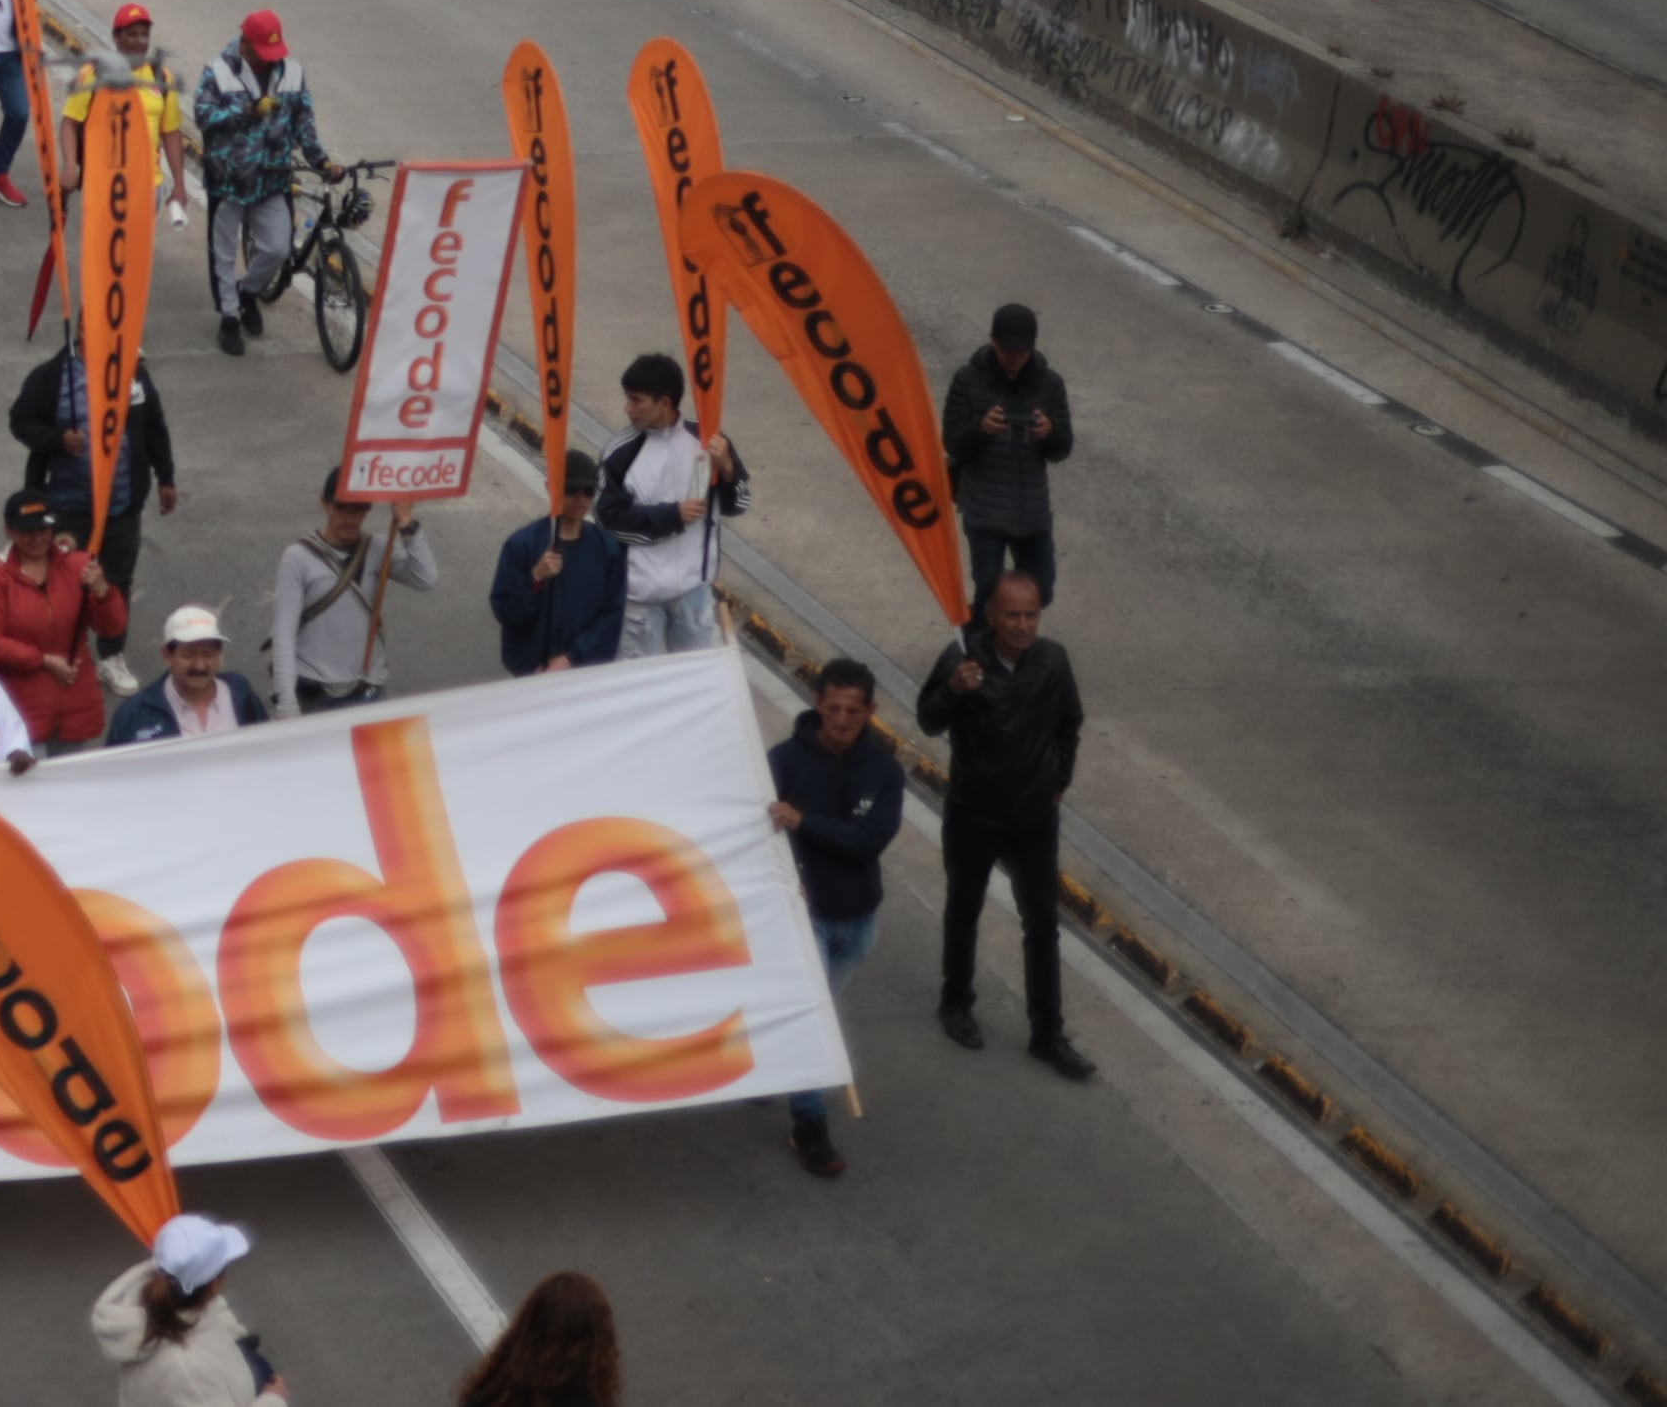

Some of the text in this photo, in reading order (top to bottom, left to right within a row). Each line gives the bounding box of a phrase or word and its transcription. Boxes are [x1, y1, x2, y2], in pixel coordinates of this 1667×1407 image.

[107, 101, 132, 458] fecode
[397, 178, 475, 429] fecode
[531, 67, 563, 419] fecode
[742, 191, 941, 530] fecode
[368, 455, 457, 491] fecode
